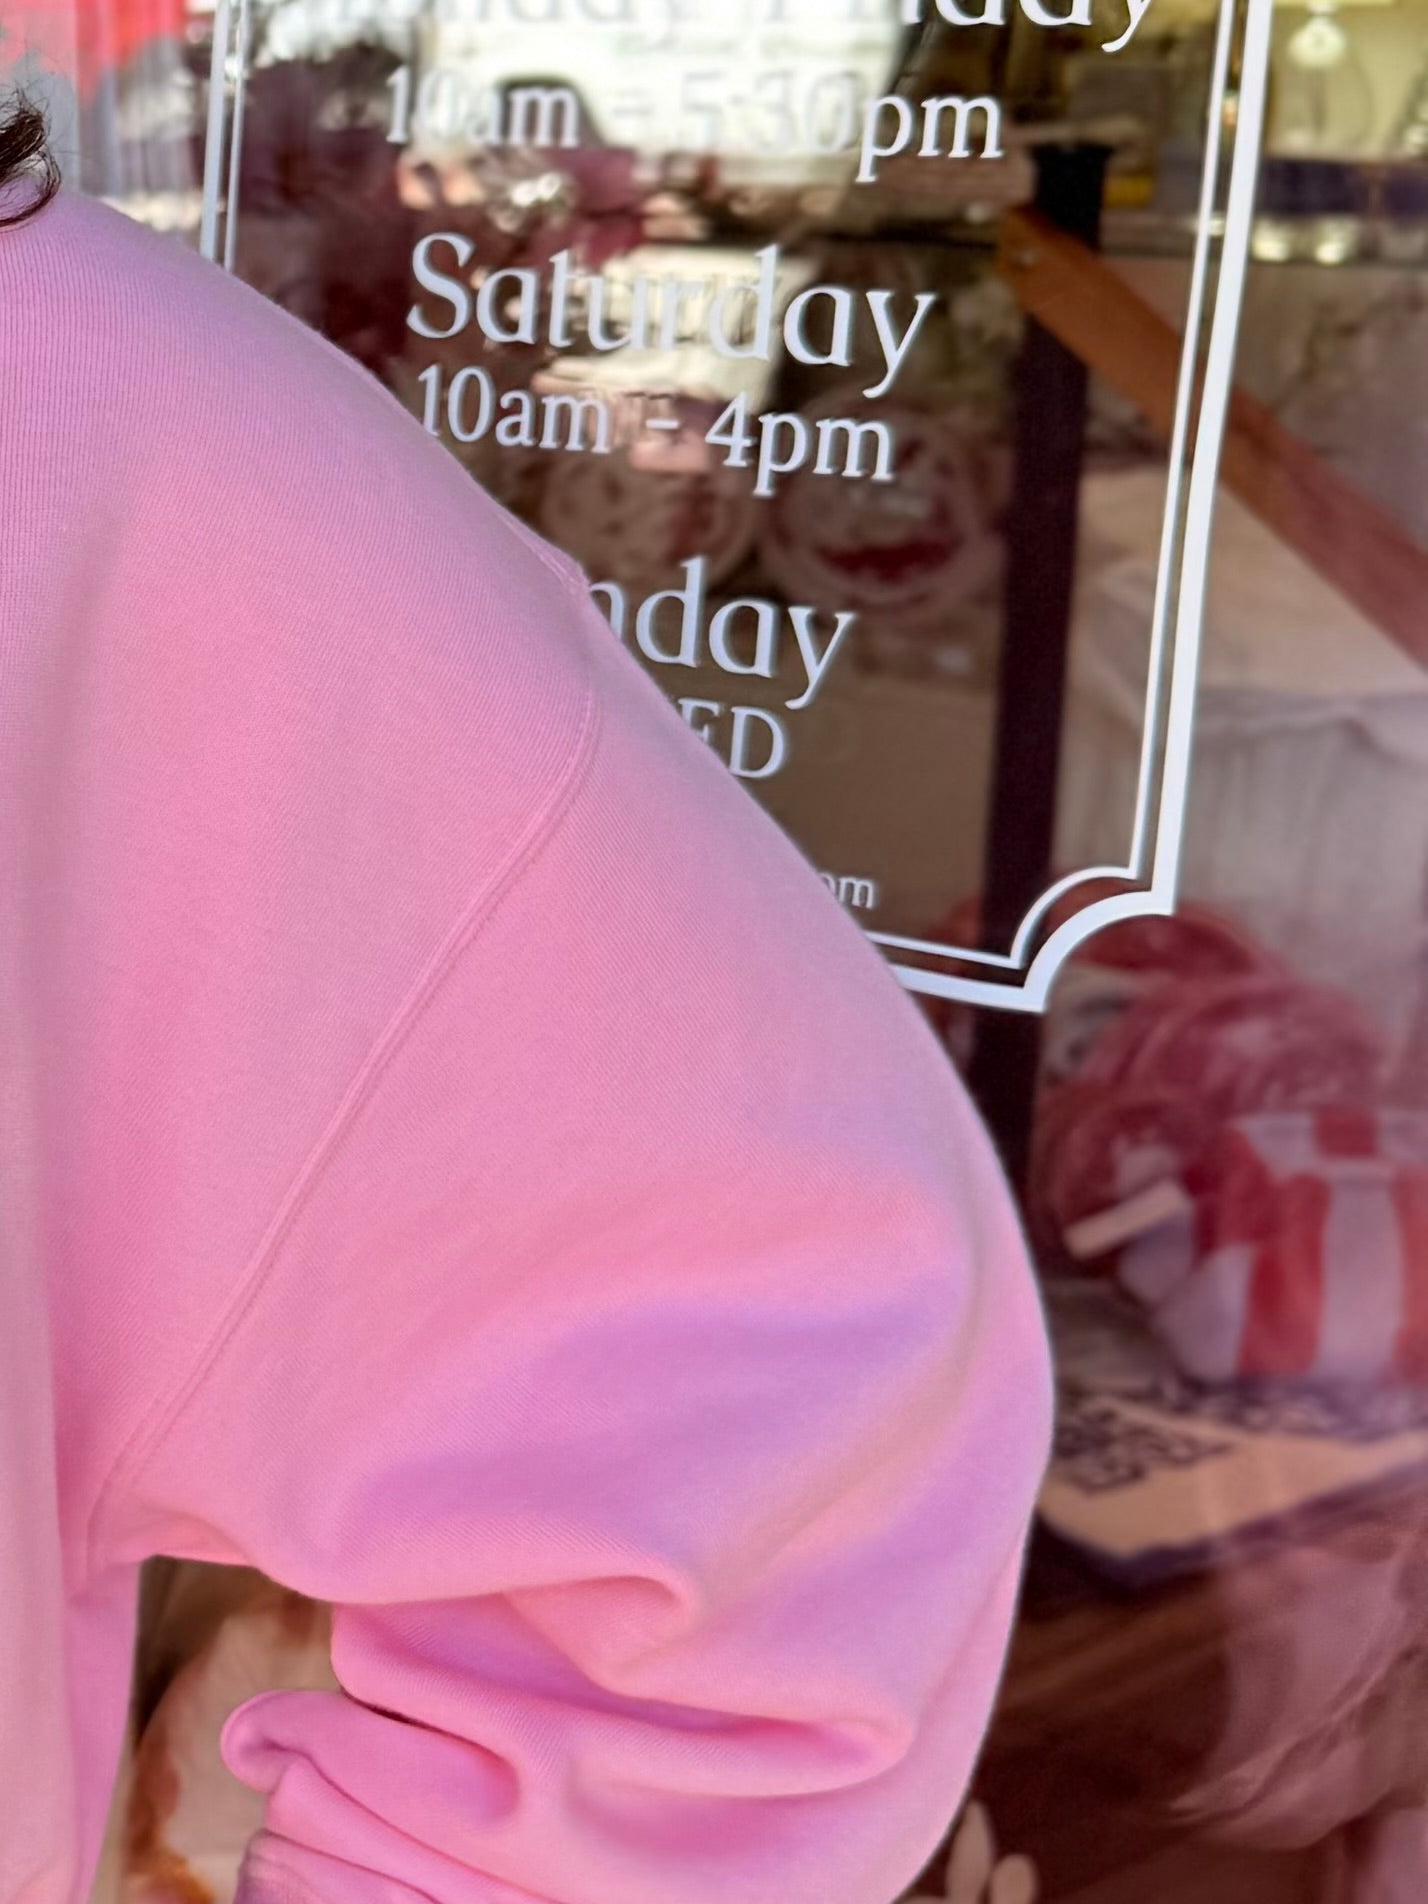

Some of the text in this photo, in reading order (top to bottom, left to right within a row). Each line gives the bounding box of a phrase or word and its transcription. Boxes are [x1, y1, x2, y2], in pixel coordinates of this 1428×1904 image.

[386, 66, 580, 148] 10am
[405, 232, 938, 399] Saturday
[416, 362, 612, 455] 10am
[704, 392, 896, 497] 4pm
